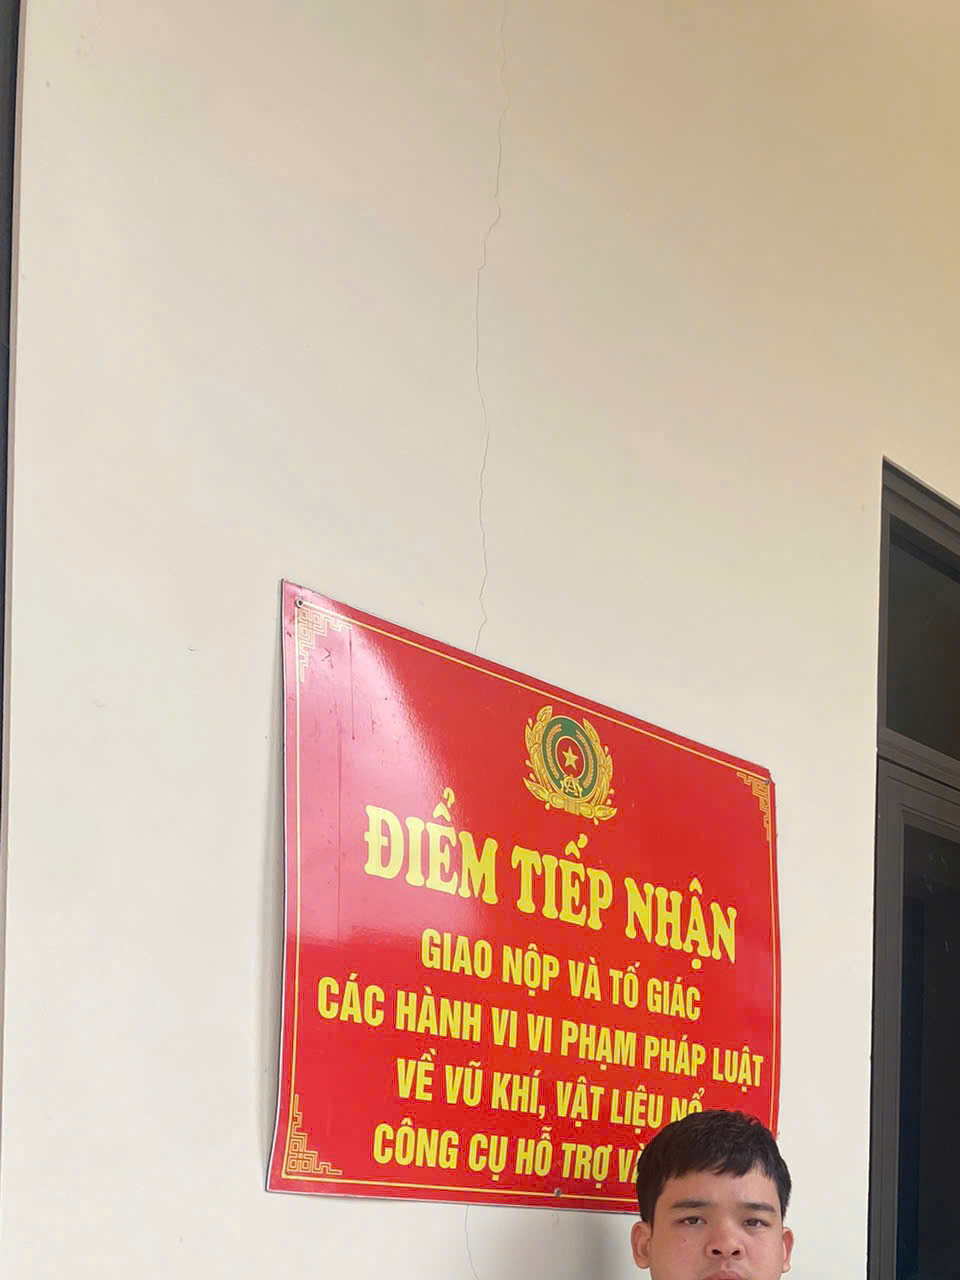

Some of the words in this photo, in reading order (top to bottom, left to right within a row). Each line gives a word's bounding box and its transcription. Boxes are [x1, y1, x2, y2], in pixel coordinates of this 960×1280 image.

[365, 787, 498, 904] ĐIỂM
[511, 833, 612, 930] TIẾP
[623, 877, 737, 969] NHẬN
[421, 928, 493, 979] GIAO
[502, 943, 560, 997] NỘP
[568, 956, 601, 1001] VÀ
[609, 960, 640, 1009] TỐ
[647, 975, 701, 1021] GIÁC
[317, 972, 385, 1027] CÁC
[395, 985, 482, 1042] HÀNH
[491, 1007, 518, 1048] VI
[527, 1013, 553, 1054] VI
[560, 1019, 637, 1071] PHẠM
[643, 1033, 707, 1077] PHÁP
[712, 1045, 764, 1092] LUẬT
[396, 1047, 436, 1101] VỀ
[445, 1060, 483, 1107] VŨ
[491, 1069, 545, 1119] KHÍ,
[556, 1075, 605, 1127] VẬT
[610, 1084, 664, 1134] LIỆU
[373, 1117, 459, 1169] CÔNG
[468, 1133, 509, 1181] CỤ
[515, 1126, 553, 1177] HỖ
[561, 1143, 613, 1189] TRỢ
